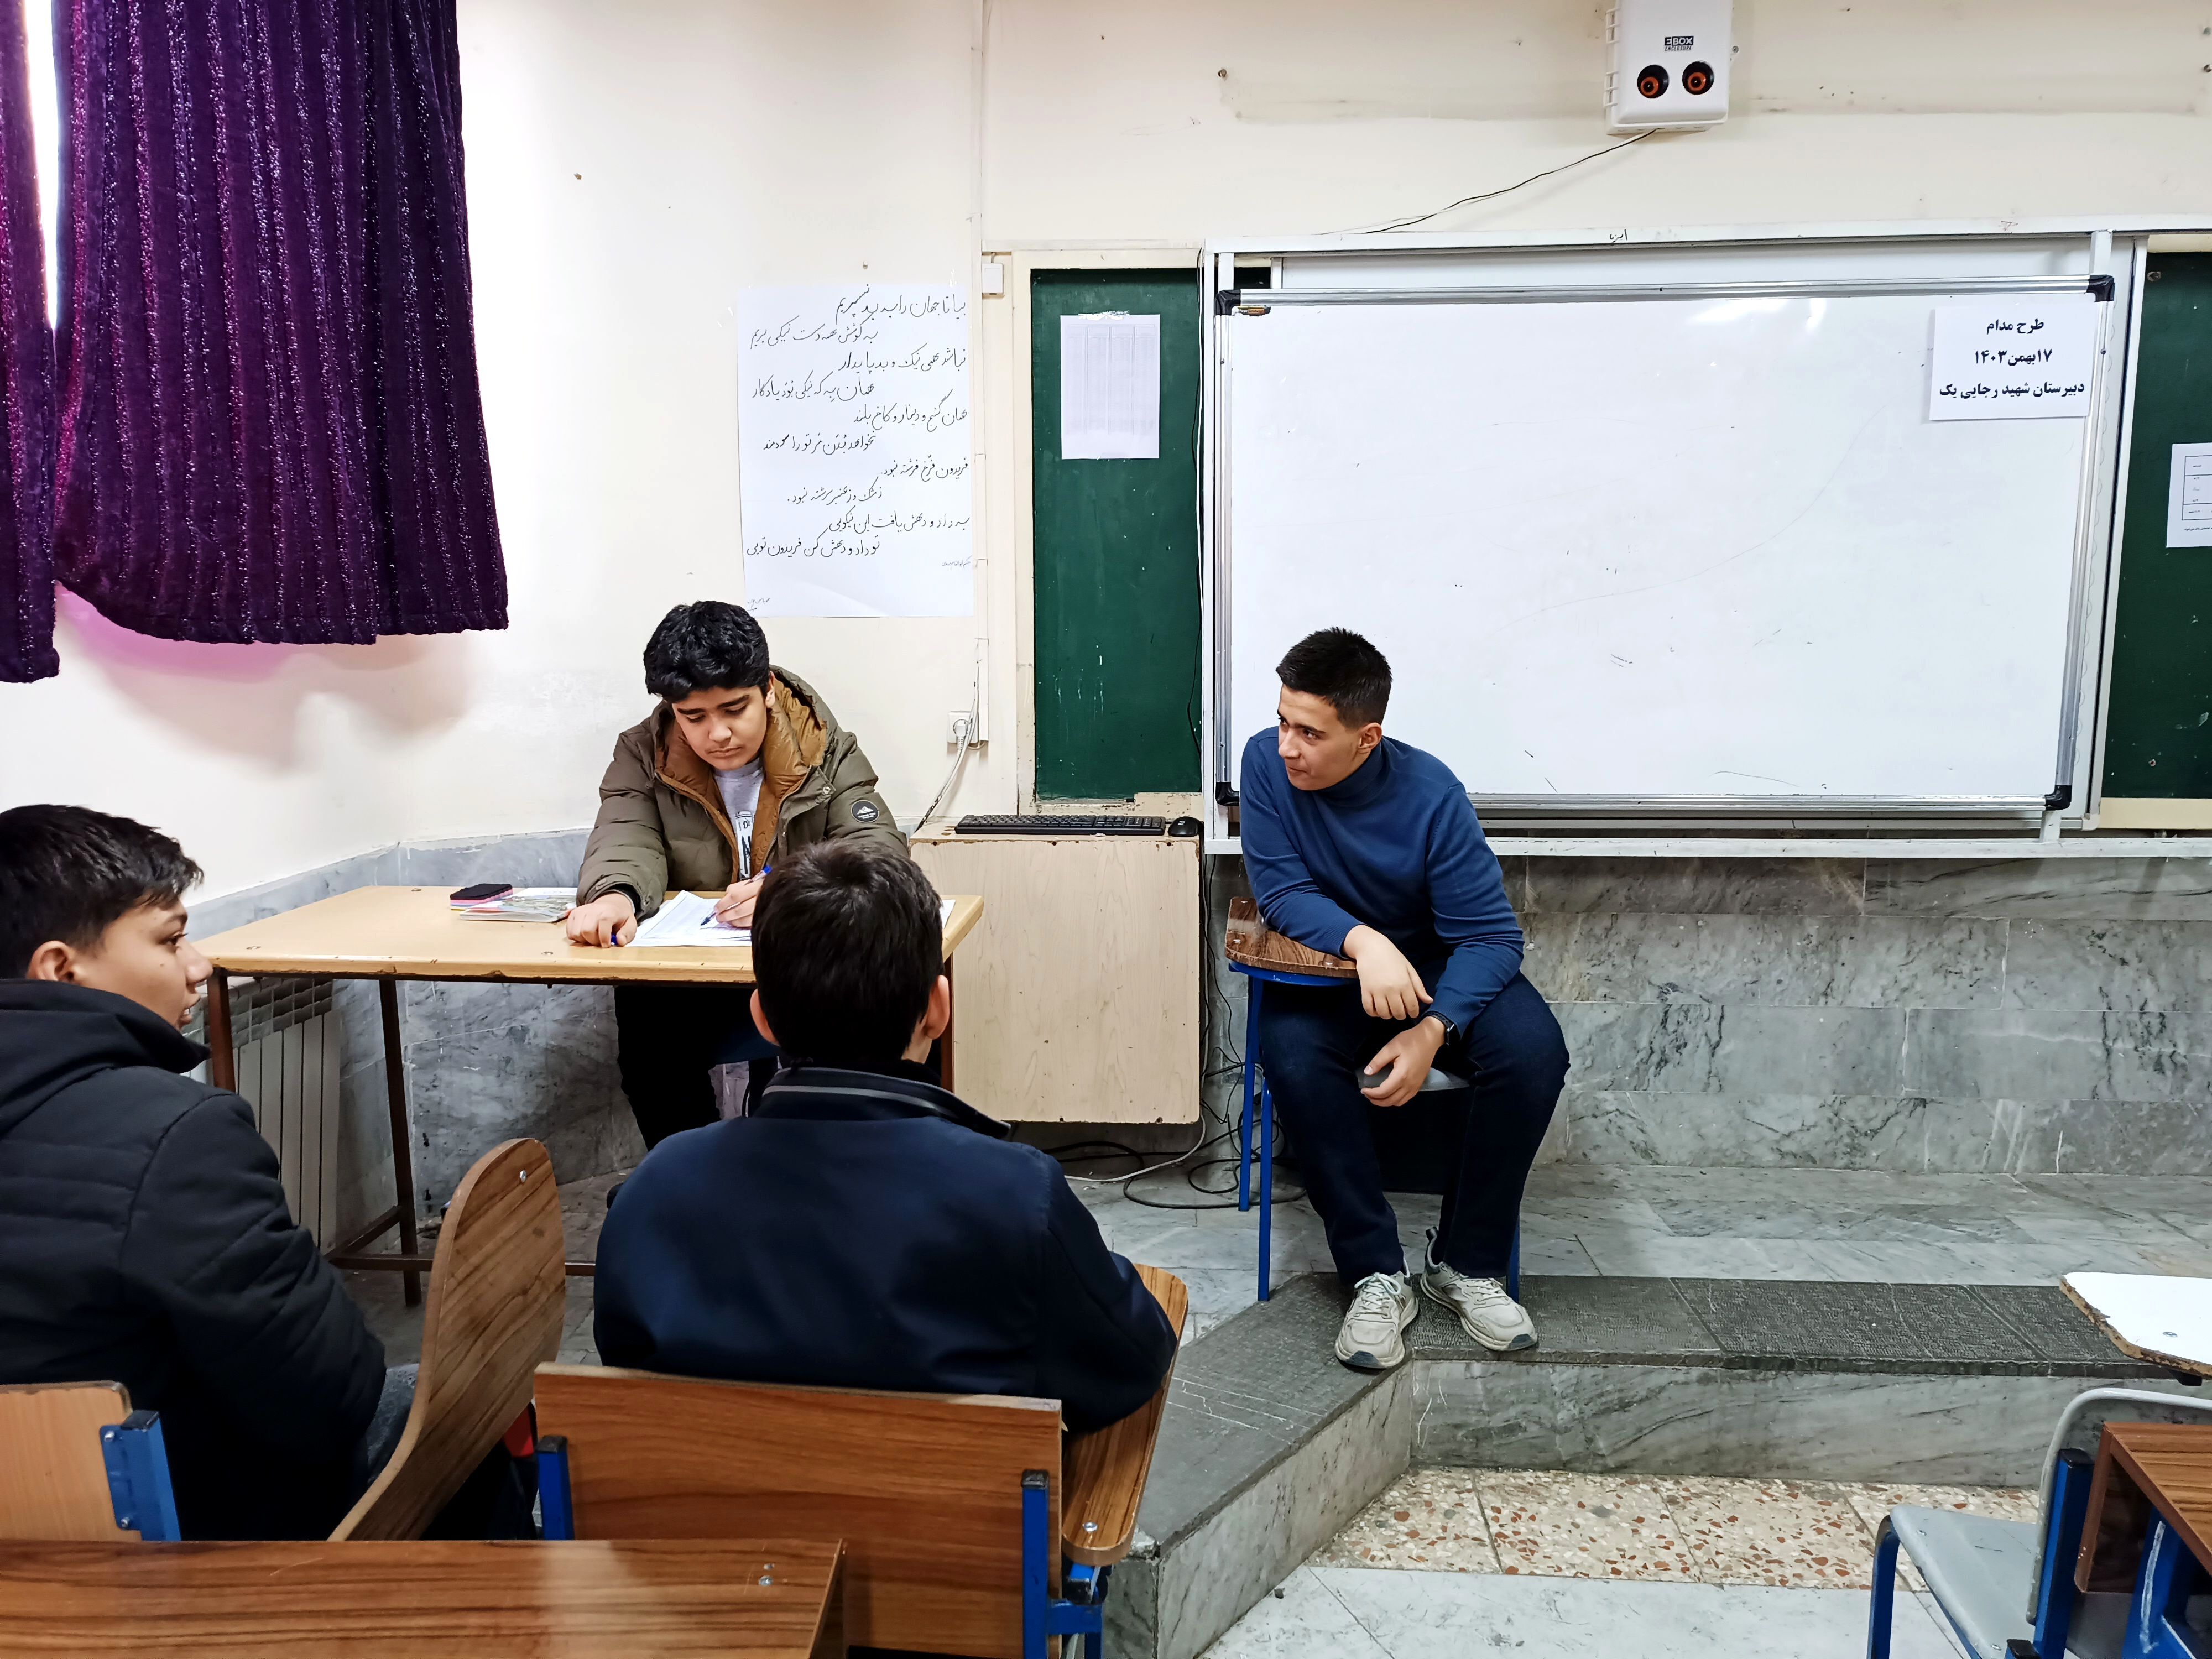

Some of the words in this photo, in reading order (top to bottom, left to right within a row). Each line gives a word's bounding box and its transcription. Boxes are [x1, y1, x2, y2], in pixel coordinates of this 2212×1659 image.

[861, 303, 879, 320] بد
[899, 294, 907, 314] را
[910, 296, 940, 317] جهان
[943, 296, 950, 313] تا
[953, 294, 966, 319] بیا
[768, 315, 800, 346] نیکی
[793, 323, 825, 341] دست
[822, 329, 837, 340] همه
[1986, 319, 2013, 335] مدام
[2017, 318, 2044, 334] طرح
[750, 329, 767, 349] بریم
[863, 331, 878, 343] به
[838, 351, 875, 374] پایدار
[898, 342, 927, 369] نیک
[921, 353, 940, 371] همی
[942, 348, 966, 372] نباشد
[795, 369, 813, 399] نیکی
[814, 371, 833, 395] که
[837, 377, 874, 401] همان
[1939, 384, 1957, 398] یک
[1960, 383, 1998, 399] رجایی
[2001, 382, 2030, 397] شهید
[2033, 382, 2085, 397] دبیرستان
[853, 403, 872, 424] بلند
[872, 403, 897, 430] کاخ
[898, 404, 919, 426] دینار
[927, 388, 953, 432] گنج
[942, 406, 967, 426] همان
[792, 436, 800, 451] را
[802, 433, 811, 451] تو
[848, 430, 876, 451] نخواهد
[900, 458, 919, 476] فرشته
[936, 457, 968, 479] فریدون
[826, 486, 848, 505] عنبر
[871, 510, 902, 531] یافت
[904, 513, 926, 531] دهش
[955, 517, 970, 530] به
[747, 536, 766, 555] تویی
[768, 537, 802, 557] فریدون
[804, 528, 828, 557] کن
[821, 540, 846, 557] دهش
[871, 535, 880, 555] تو
